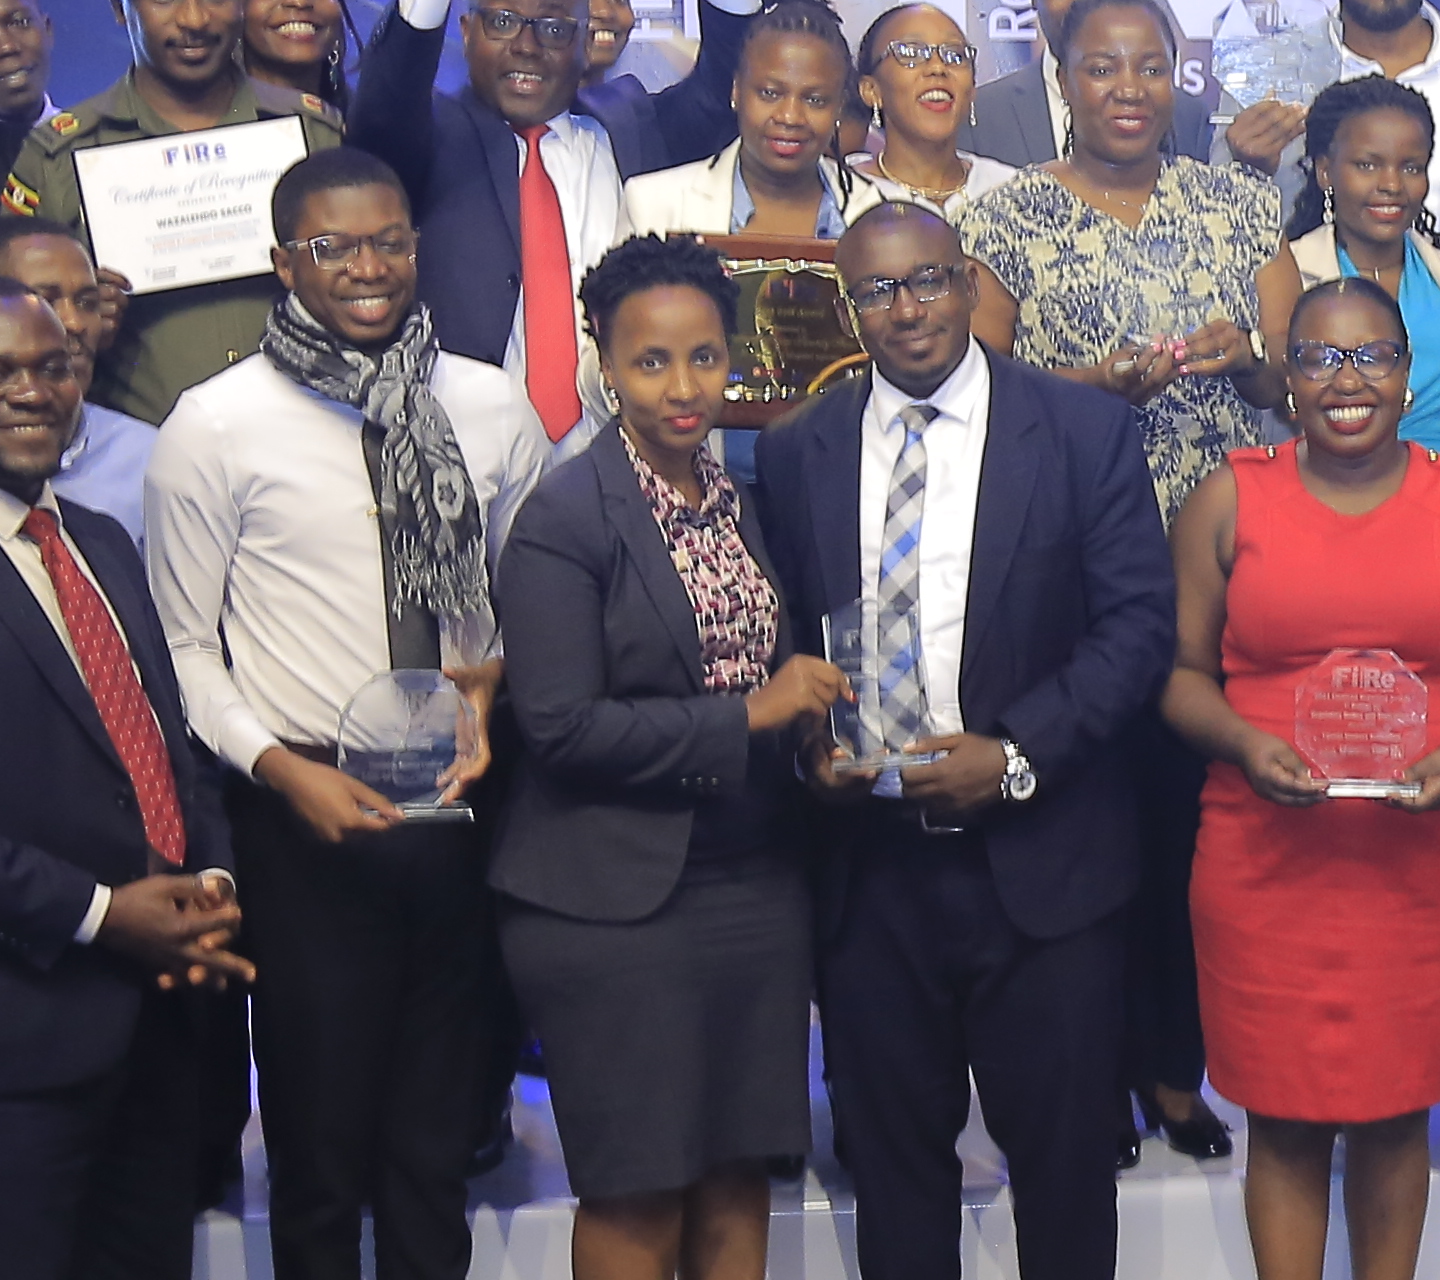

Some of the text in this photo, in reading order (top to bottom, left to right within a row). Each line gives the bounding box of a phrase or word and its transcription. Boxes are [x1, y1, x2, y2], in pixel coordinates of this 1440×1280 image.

[162, 141, 228, 167] FiRe
[108, 182, 181, 207] Certificate
[183, 178, 200, 196] of
[220, 203, 253, 218] SACCO
[1332, 666, 1396, 690] FiRe
